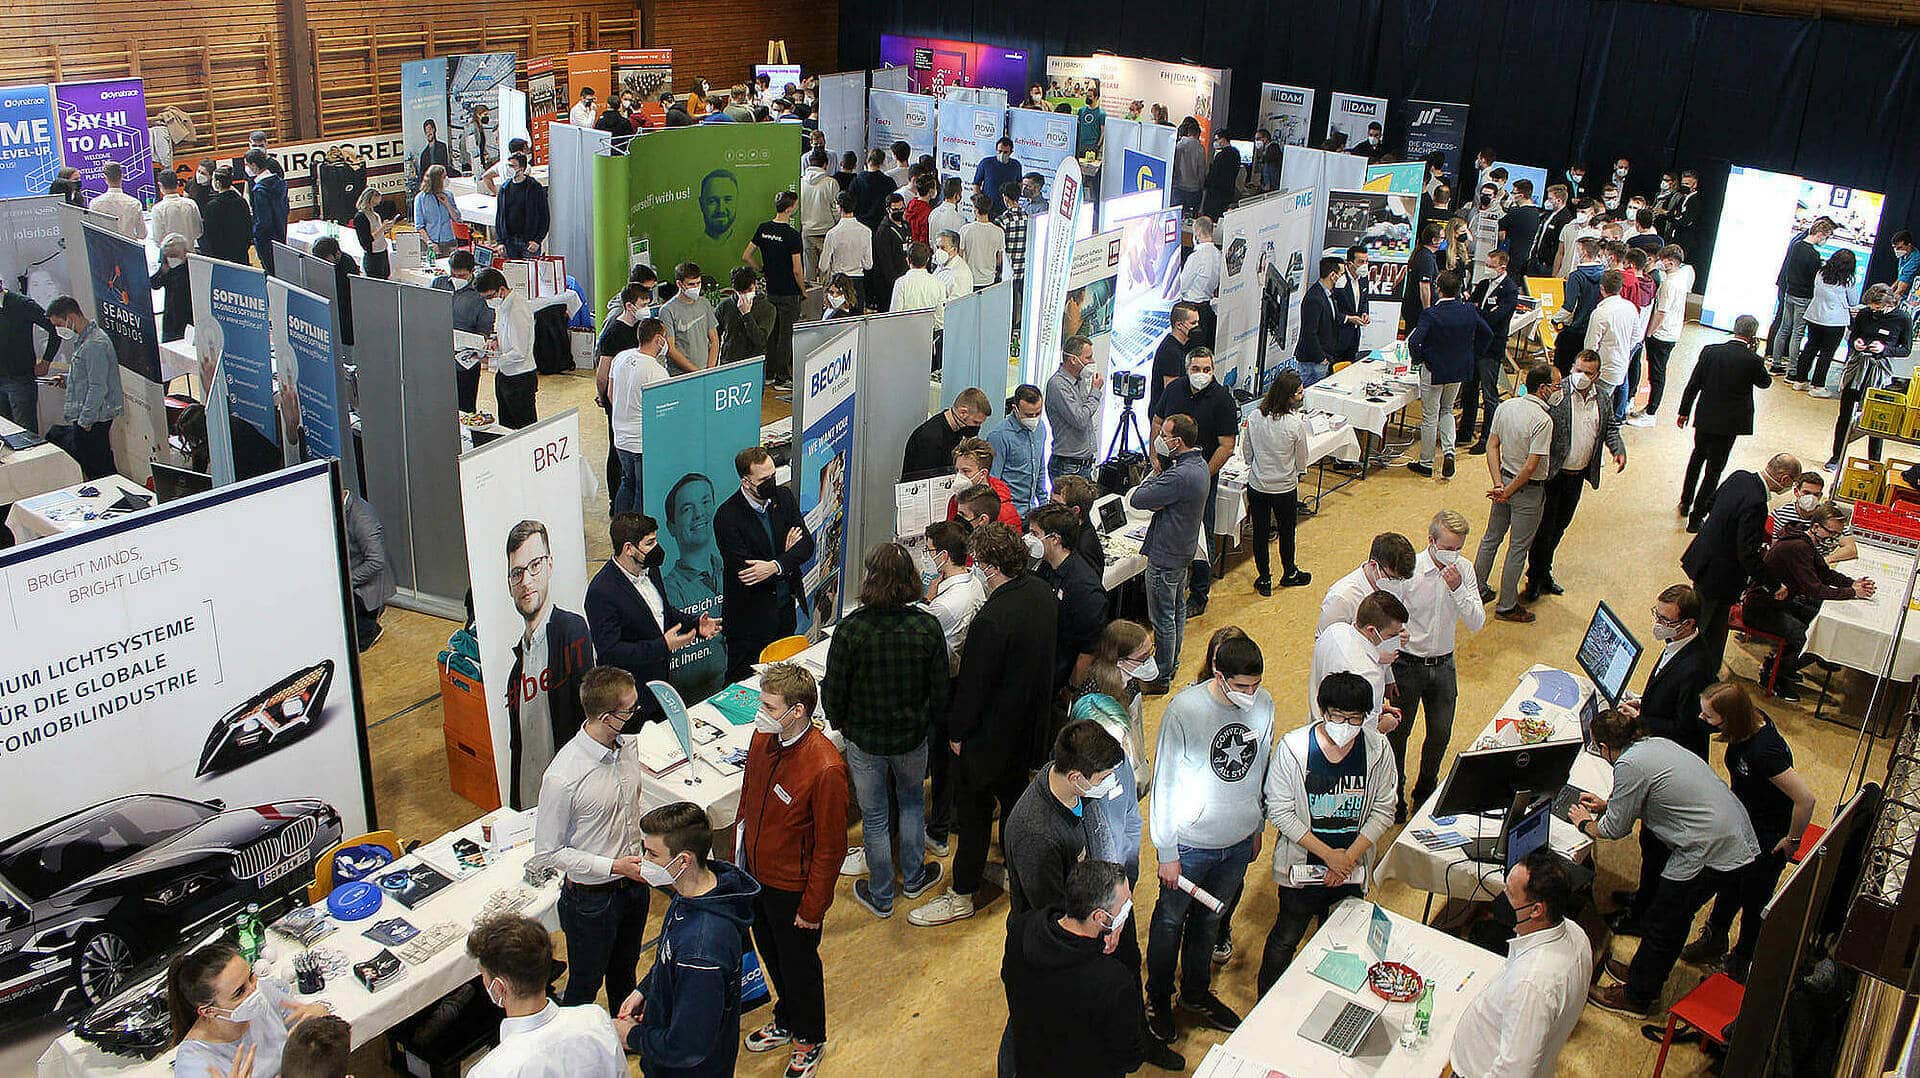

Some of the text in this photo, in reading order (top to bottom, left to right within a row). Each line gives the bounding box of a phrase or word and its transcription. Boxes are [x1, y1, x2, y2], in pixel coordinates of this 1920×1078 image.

[1281, 93, 1303, 104] DAM
[1352, 103, 1375, 114] DAM
[65, 110, 127, 132] SAY HI
[906, 112, 927, 122] nova
[975, 123, 996, 134] nova
[1046, 132, 1068, 143] nova
[67, 132, 130, 153] TO A.I.
[675, 186, 691, 200] us!
[1295, 191, 1313, 210] PKE
[213, 288, 266, 311] SOFTLINE
[103, 301, 142, 329] SEADEV
[103, 317, 143, 344] STUDIOS
[288, 314, 330, 344] SOFTLINE
[811, 349, 852, 398] BECOM
[715, 381, 753, 412] BRZ
[819, 427, 836, 447] WANT
[533, 436, 570, 473] BRZ
[27, 546, 144, 593] BRIGHT MINDS,
[68, 557, 182, 604] BRIGHT LIGHTS.
[47, 615, 196, 681] LICHTSYSTEME
[681, 646, 713, 665] Ihnen.
[34, 688, 70, 714] DIE
[75, 652, 168, 699] GLOBALE
[1215, 727, 1245, 749] CONVER
